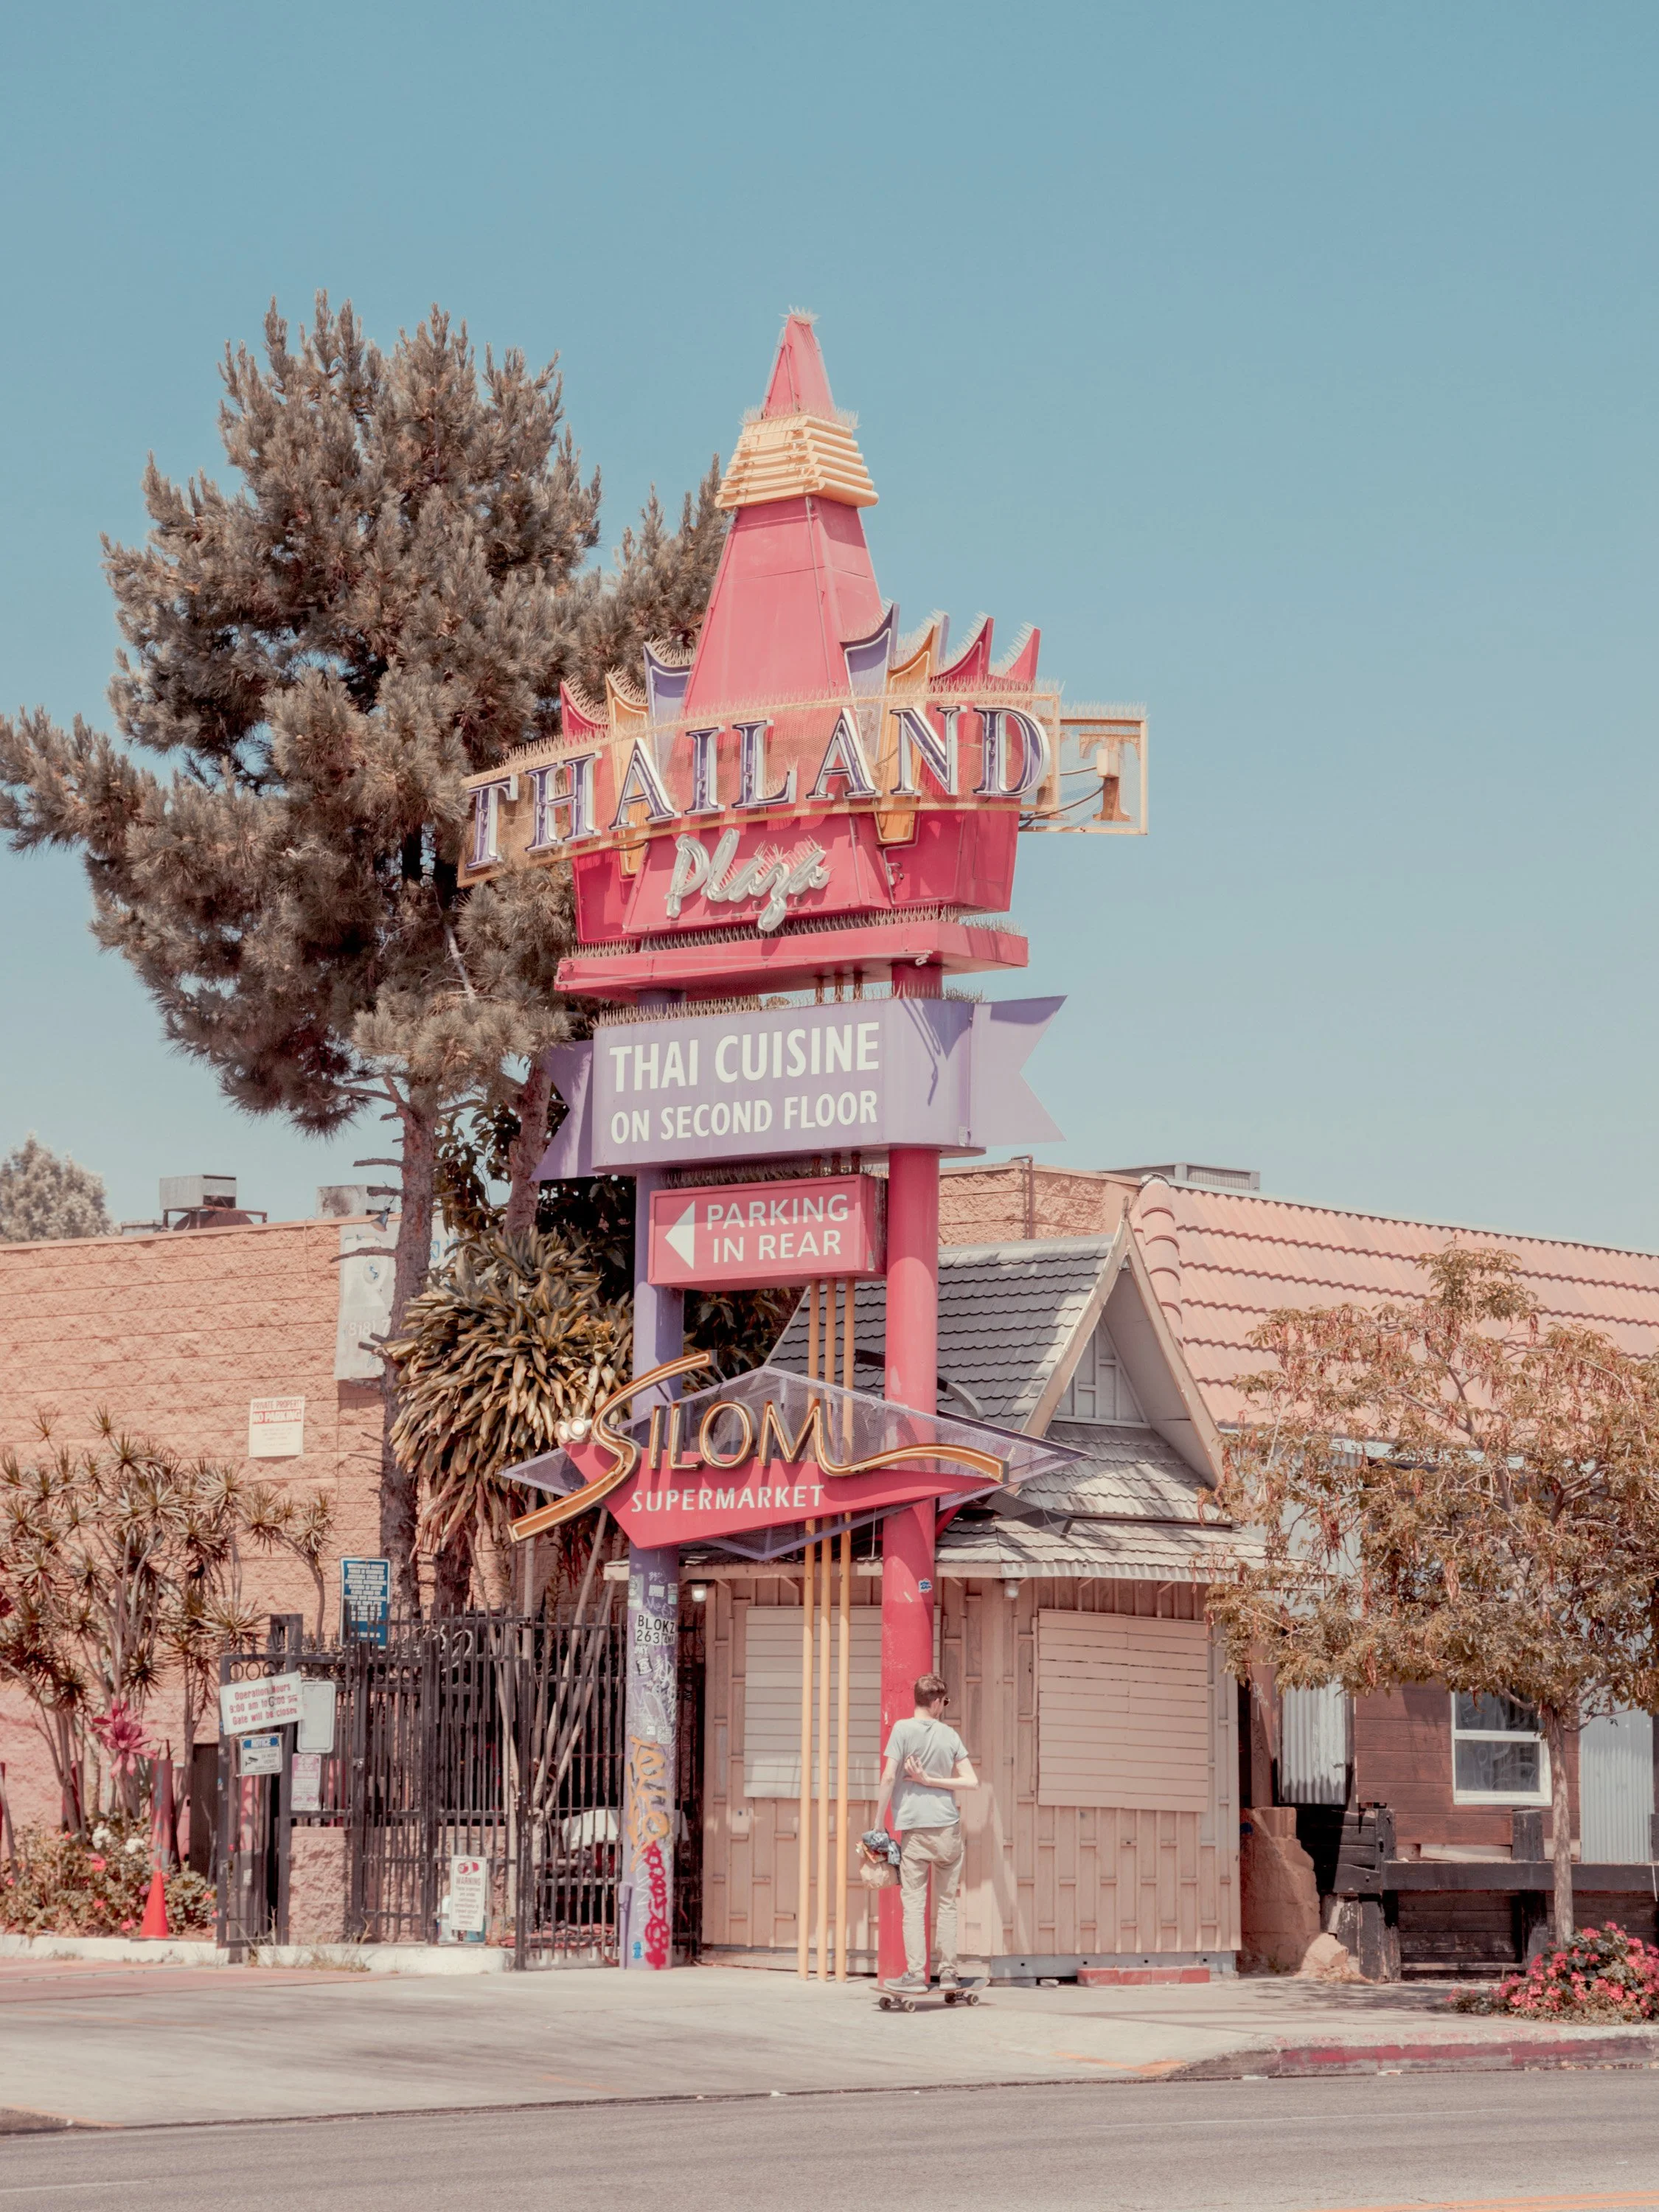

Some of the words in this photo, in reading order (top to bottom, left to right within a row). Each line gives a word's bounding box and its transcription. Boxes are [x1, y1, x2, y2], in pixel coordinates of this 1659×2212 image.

[466, 705, 1051, 871] THAILAND
[664, 827, 830, 932] Plaza
[609, 1039, 699, 1093] THAI
[714, 1022, 880, 1084] CUISINE
[611, 1109, 650, 1144] ON
[660, 1099, 773, 1141] SECOND
[784, 1089, 877, 1129] FLOOR
[706, 1193, 849, 1231] PARKING
[712, 1236, 745, 1264] IN
[759, 1229, 842, 1261] REAR
[507, 1349, 1009, 1543] SILOM
[631, 1484, 825, 1514] SUPERMARKET
[636, 1630, 660, 1644] 263
[234, 1687, 270, 1700] Operation
[248, 1702, 259, 1710] am
[262, 1700, 268, 1708] to
[232, 1716, 248, 1725] Gate
[251, 1711, 262, 1722] will
[265, 1710, 274, 1719] be
